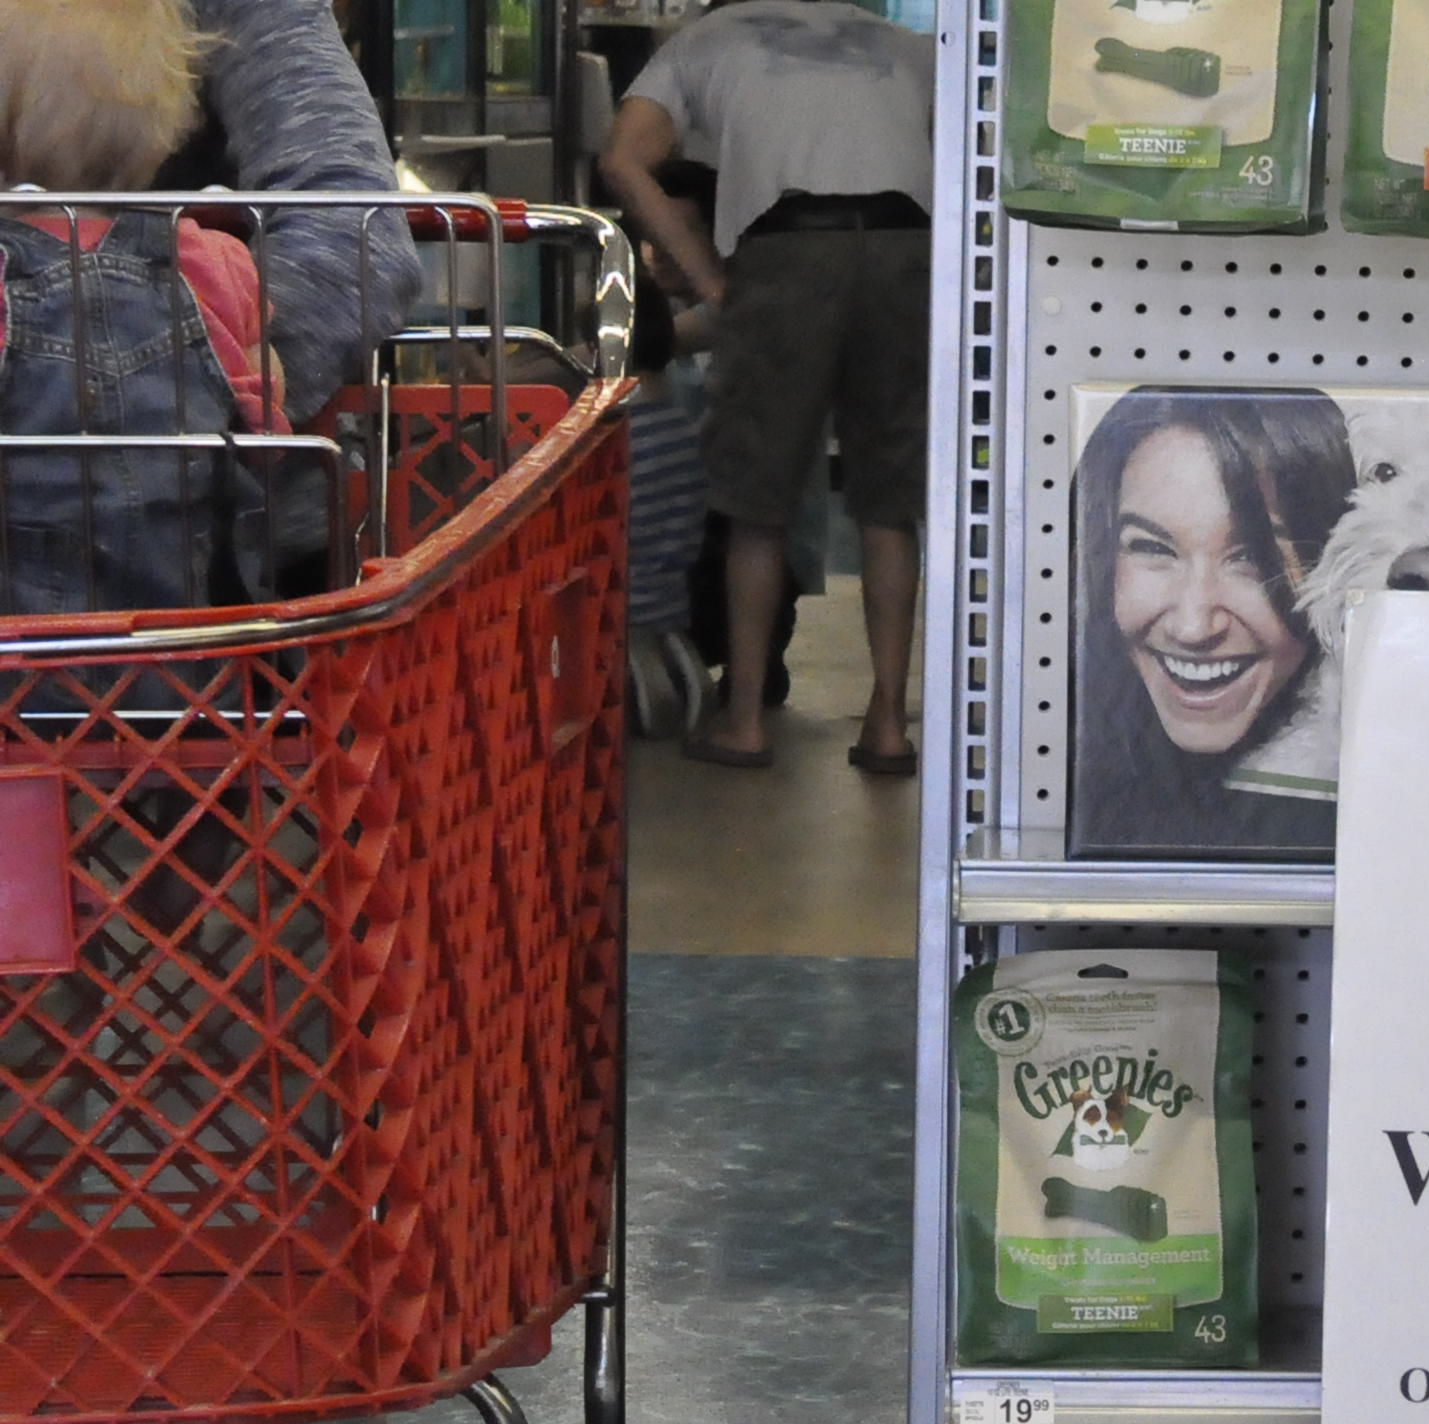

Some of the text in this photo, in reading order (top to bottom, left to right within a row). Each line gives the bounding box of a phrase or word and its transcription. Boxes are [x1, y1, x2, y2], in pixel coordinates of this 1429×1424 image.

[1119, 137, 1187, 154] TEENIE
[1238, 154, 1274, 186] 43
[1013, 1048, 1194, 1120] Greenies
[1007, 1246, 1211, 1270] Weight Management
[1070, 1305, 1138, 1321] TEENIE
[1194, 1314, 1227, 1344] 43
[1000, 1398, 1032, 1423] 19
